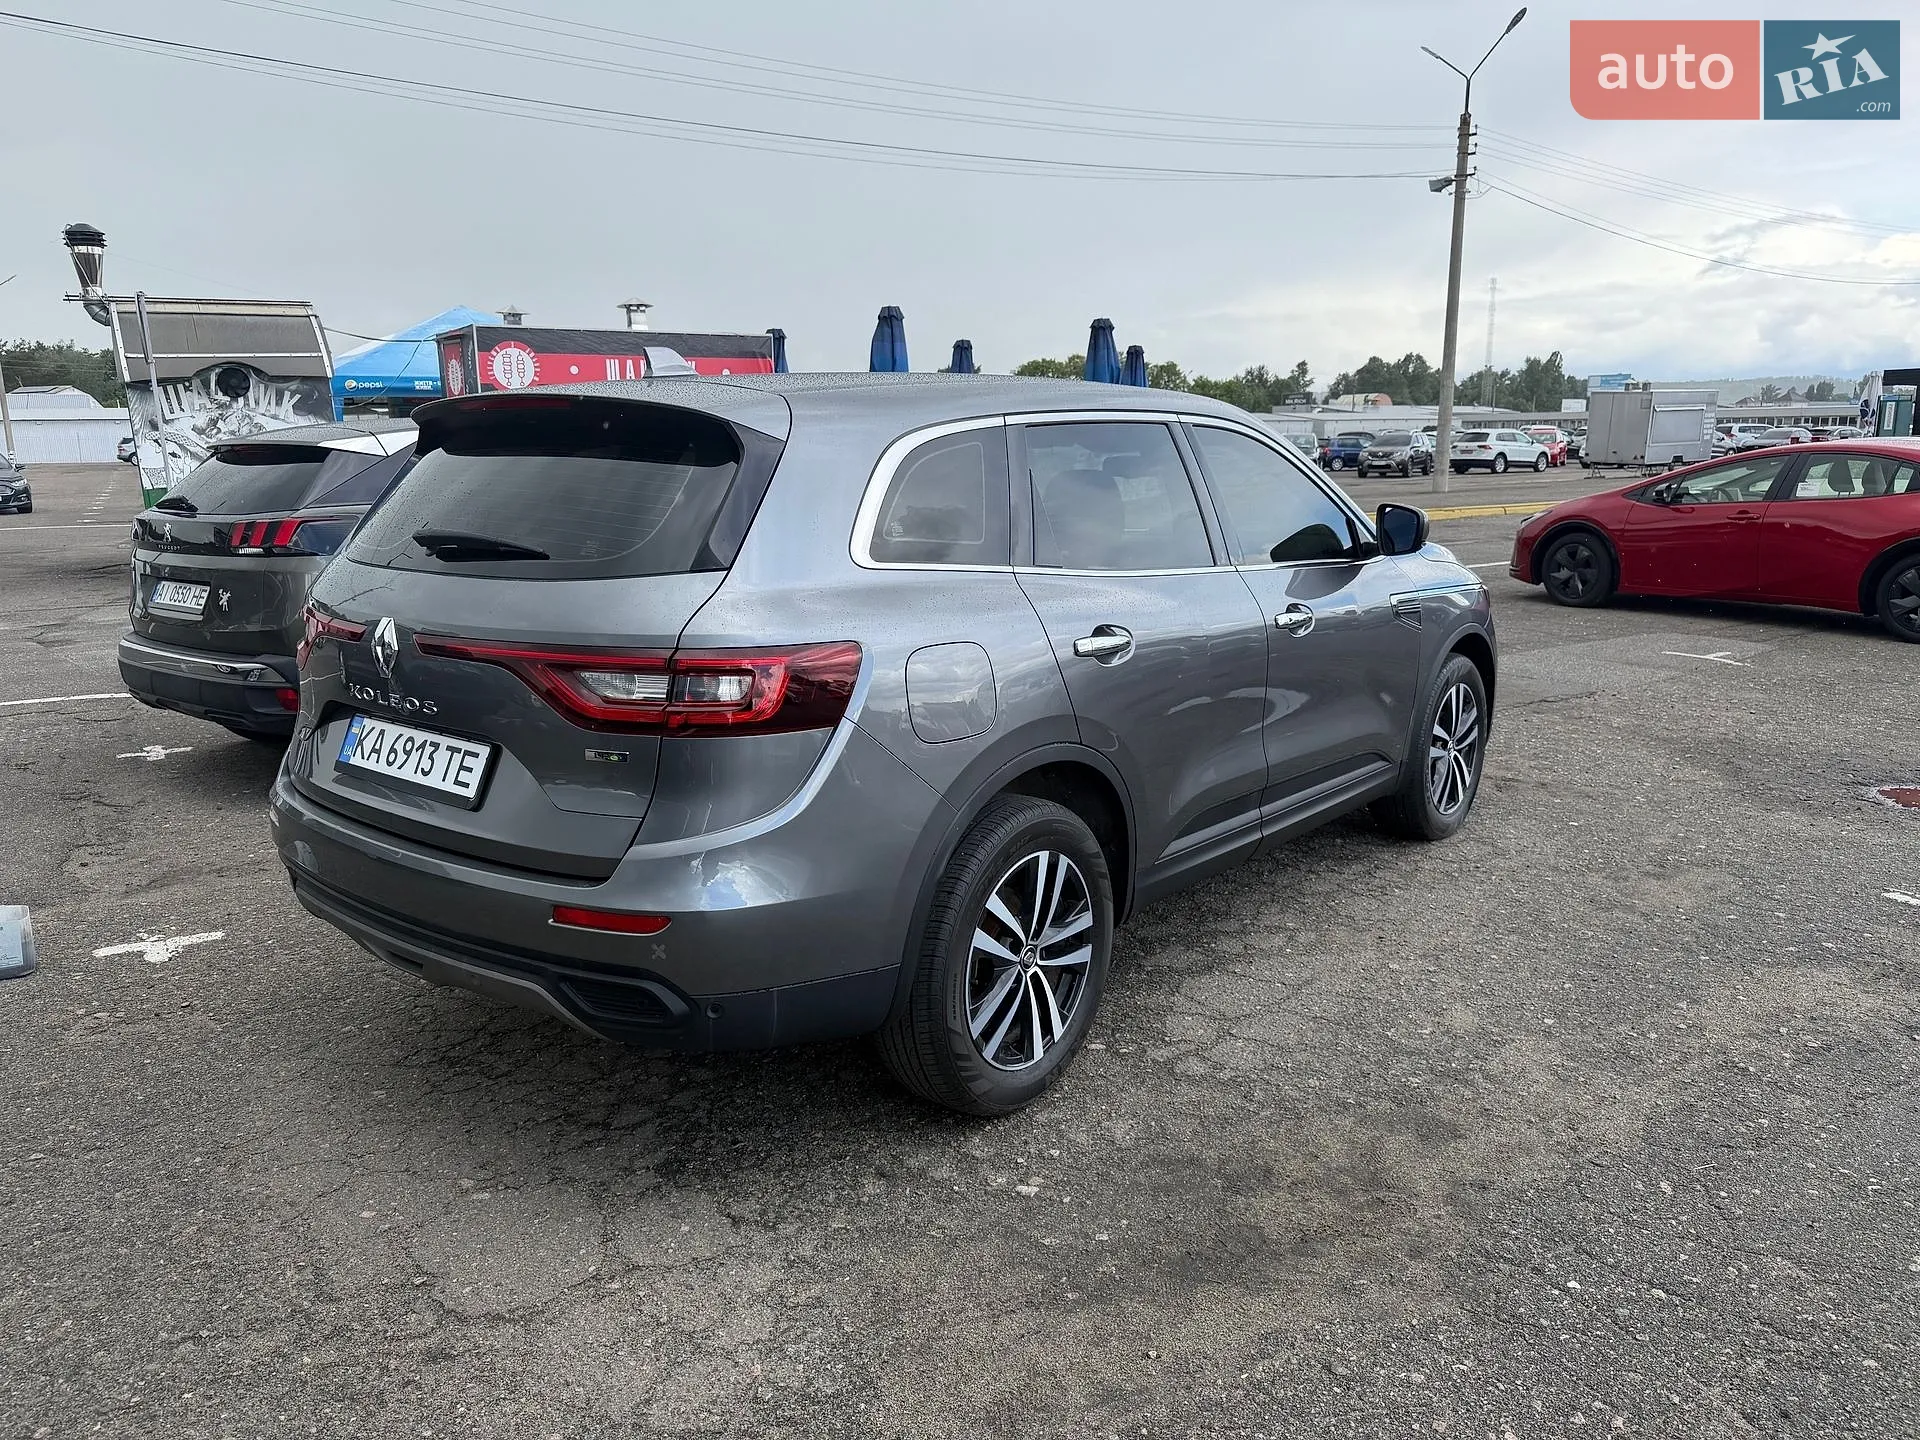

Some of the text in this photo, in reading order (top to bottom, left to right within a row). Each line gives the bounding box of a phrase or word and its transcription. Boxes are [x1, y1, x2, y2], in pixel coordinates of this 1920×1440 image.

[358, 380, 383, 390] pepsi
[348, 683, 439, 716] KOLEOS
[352, 724, 480, 789] KA 6913 TE
